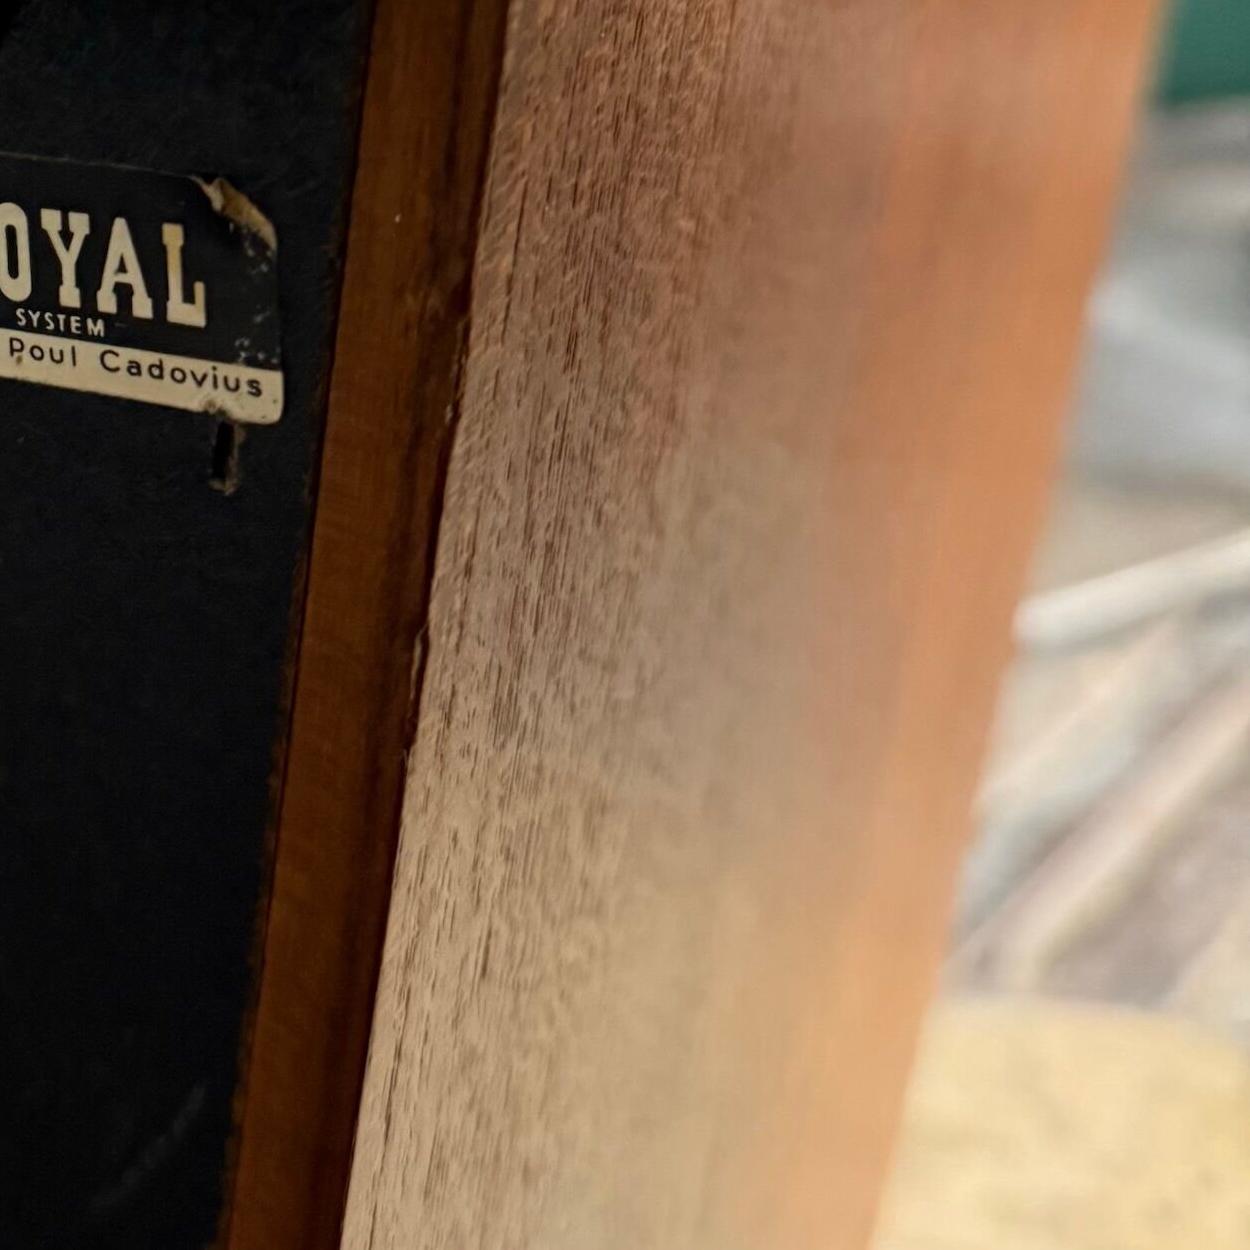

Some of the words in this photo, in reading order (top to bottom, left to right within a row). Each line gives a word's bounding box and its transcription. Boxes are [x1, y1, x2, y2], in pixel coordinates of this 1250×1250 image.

[15, 308, 106, 337] SYSTEM
[9, 337, 77, 367] Poul
[100, 350, 263, 398] Cadovius
